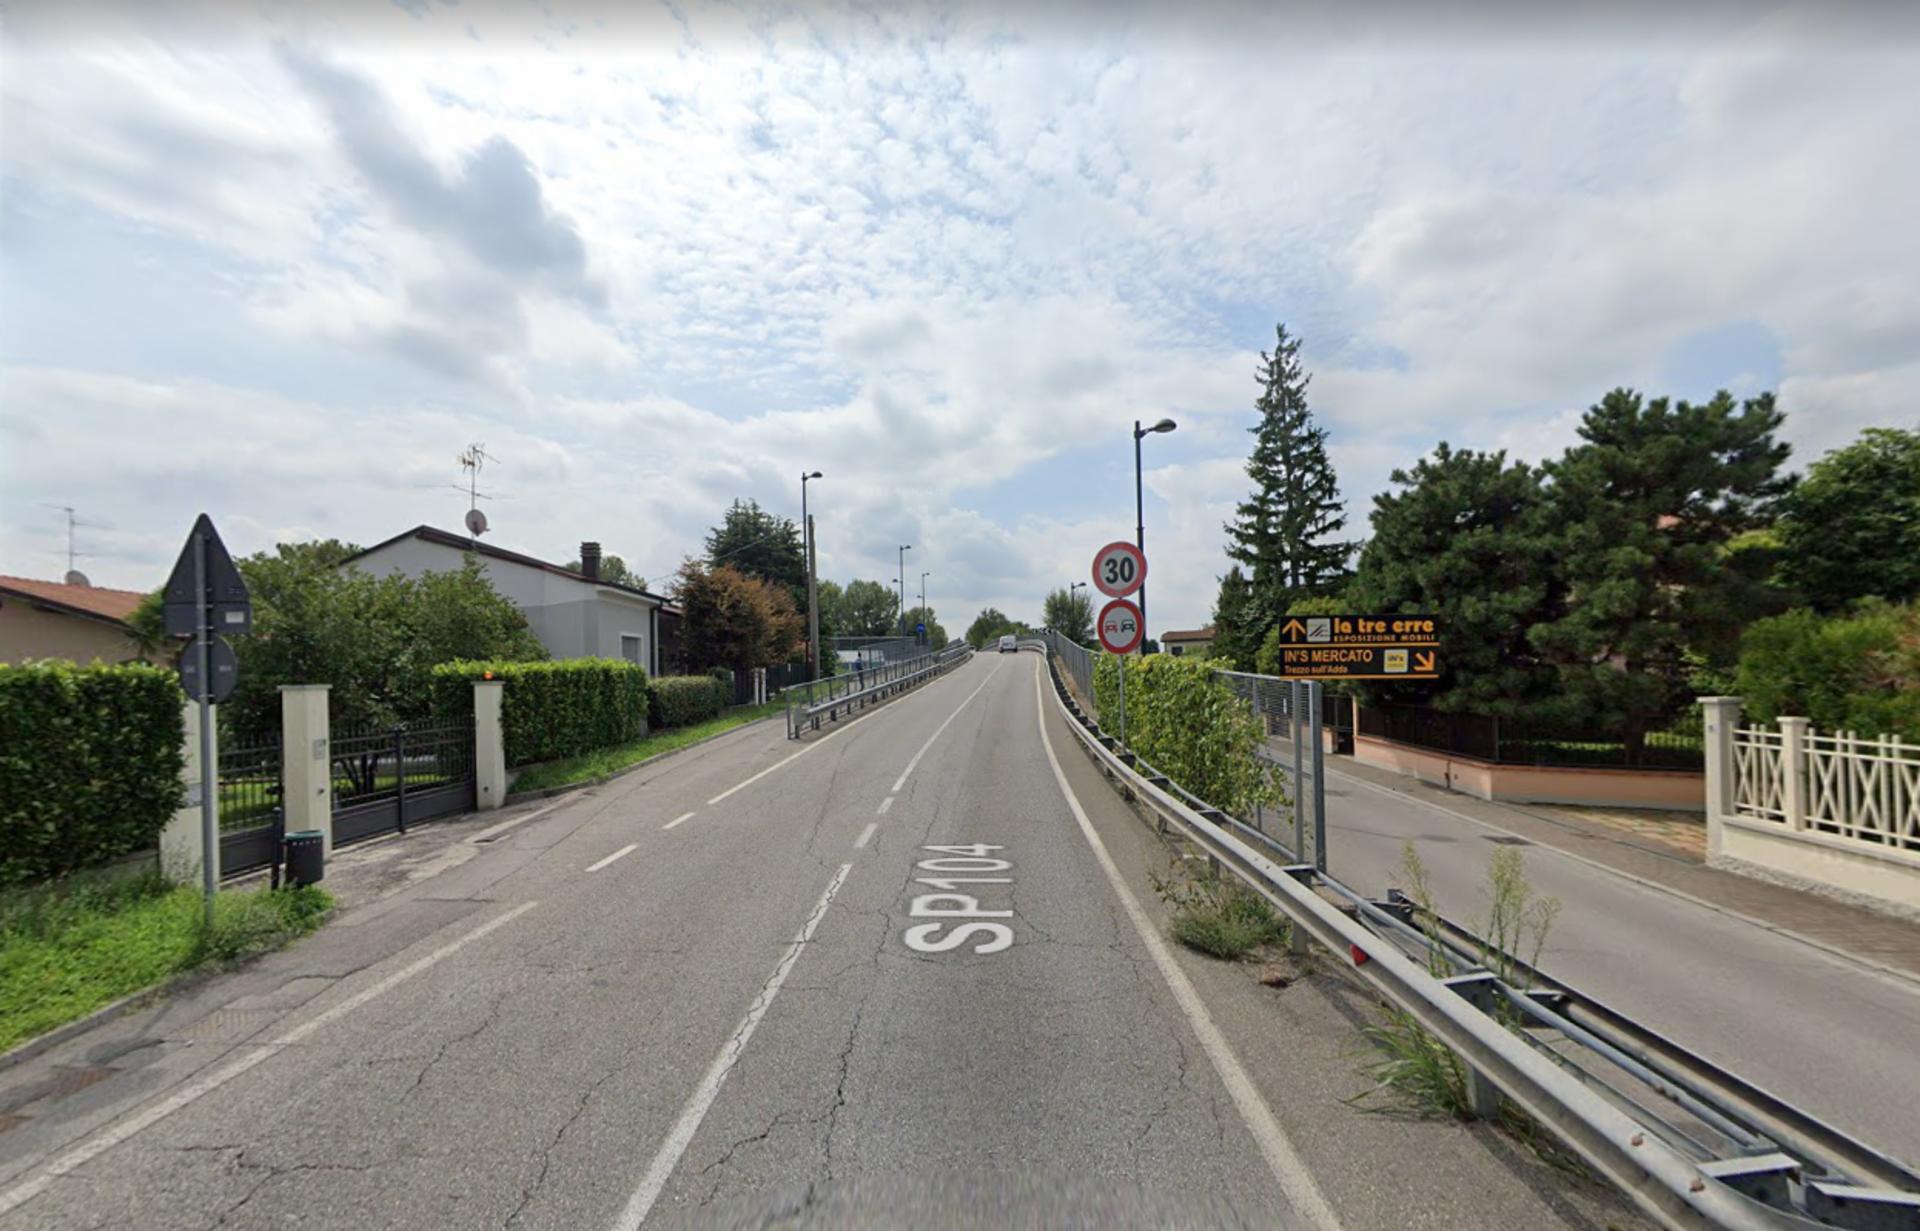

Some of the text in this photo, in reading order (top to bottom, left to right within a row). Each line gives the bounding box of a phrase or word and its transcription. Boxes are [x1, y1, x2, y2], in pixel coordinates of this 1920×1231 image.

[1104, 556, 1135, 585] 30
[1334, 618, 1435, 634] la tre erre
[1333, 634, 1396, 642] ESPOSIZIONE
[1284, 649, 1373, 663] IN'S MERCATO
[1284, 665, 1311, 674] Trezzo
[904, 843, 1013, 954] SP104
